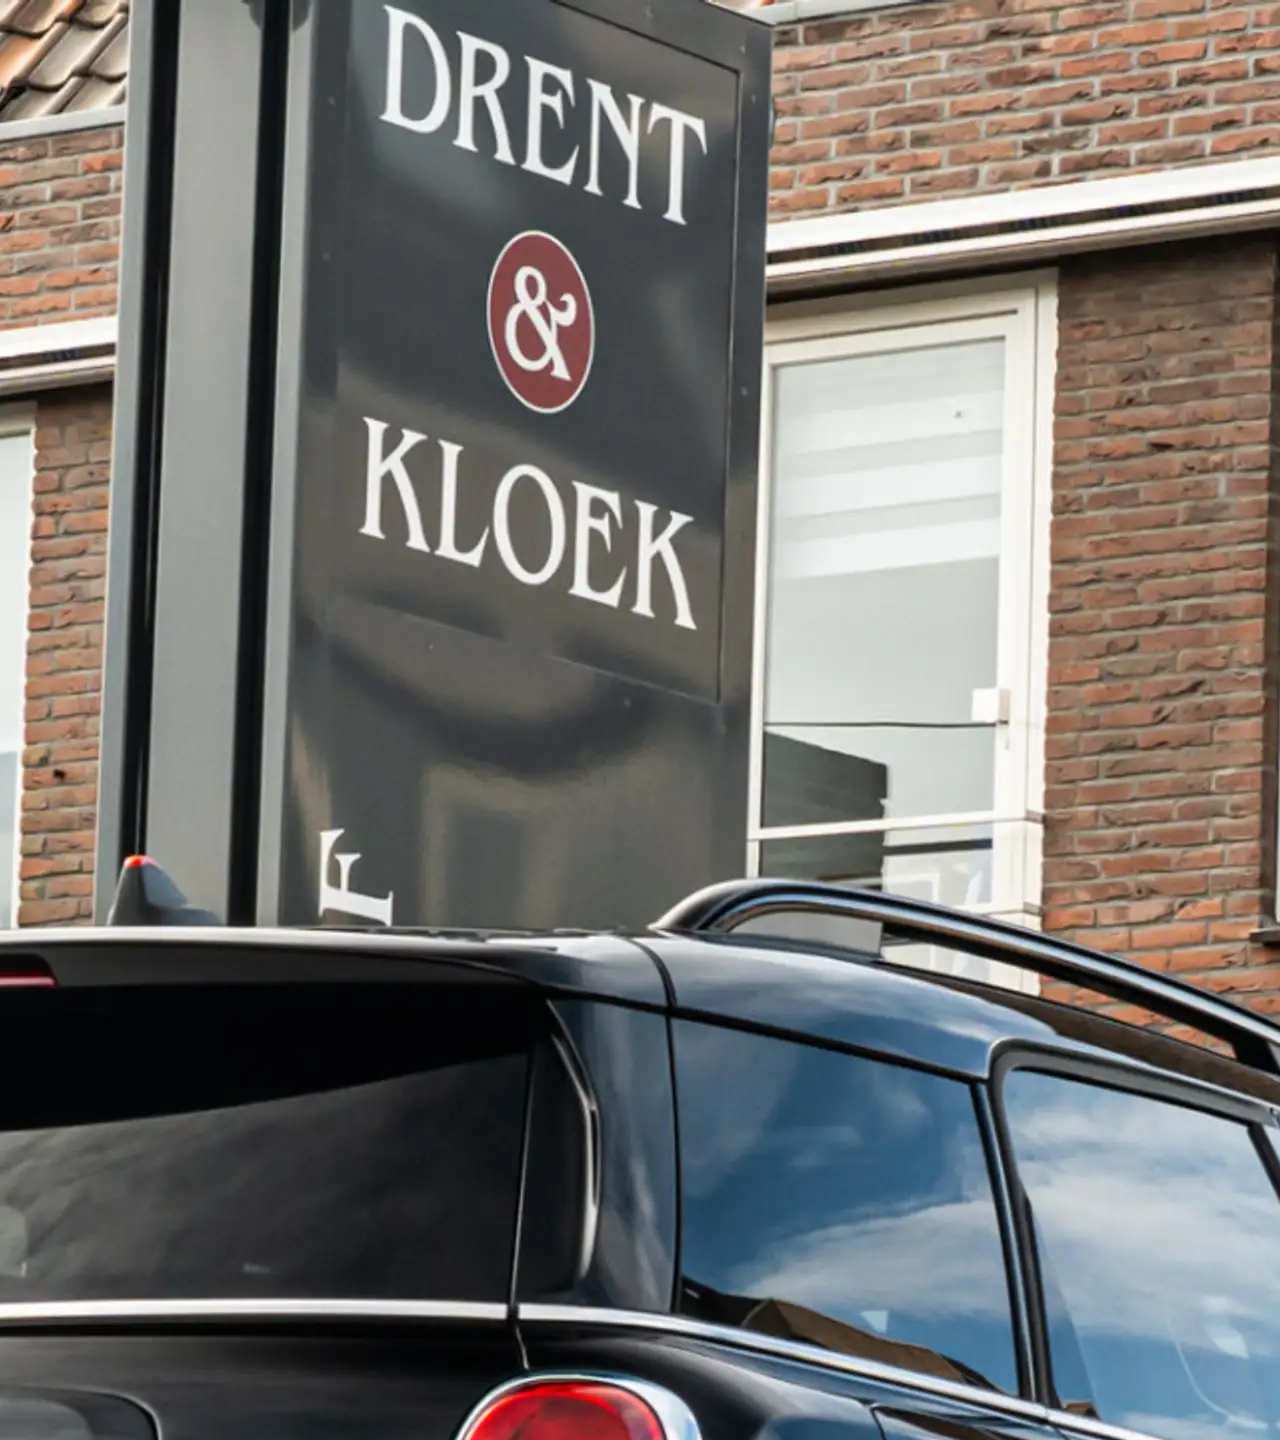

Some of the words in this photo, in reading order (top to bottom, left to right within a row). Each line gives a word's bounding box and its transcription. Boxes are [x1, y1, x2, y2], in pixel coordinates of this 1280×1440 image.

[380, 3, 708, 226] DRENT
[504, 264, 577, 382] &
[359, 416, 698, 631] KLOEK
